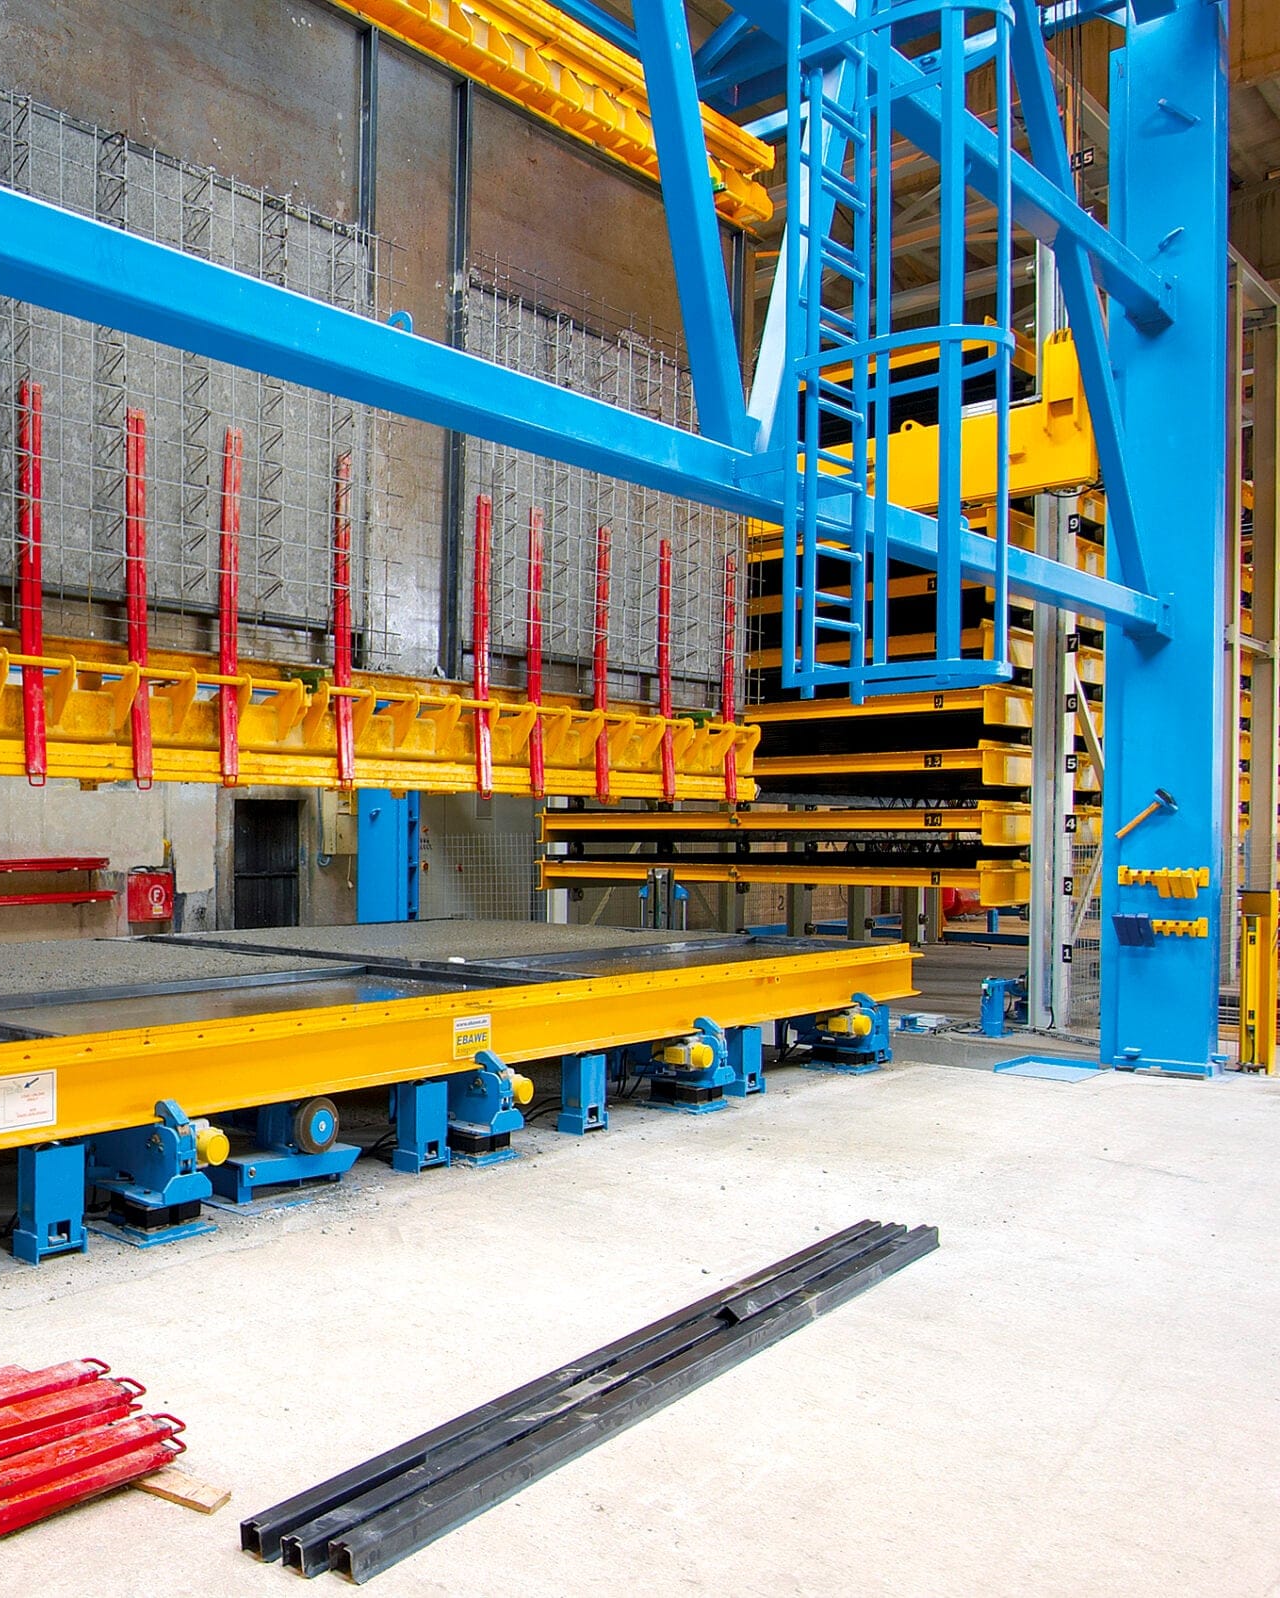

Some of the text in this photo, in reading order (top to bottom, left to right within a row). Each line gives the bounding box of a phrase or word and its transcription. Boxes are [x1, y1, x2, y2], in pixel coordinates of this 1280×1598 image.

[1070, 518, 1079, 529] 9
[1068, 637, 1078, 649] 7
[1067, 697, 1077, 709] 6
[1067, 758, 1076, 770] 5
[1066, 818, 1075, 830] 4
[1064, 880, 1073, 892] 3
[153, 889, 161, 902] F
[777, 895, 785, 911] 2
[1063, 948, 1072, 960] 1
[456, 1031, 488, 1046] EBAWE
